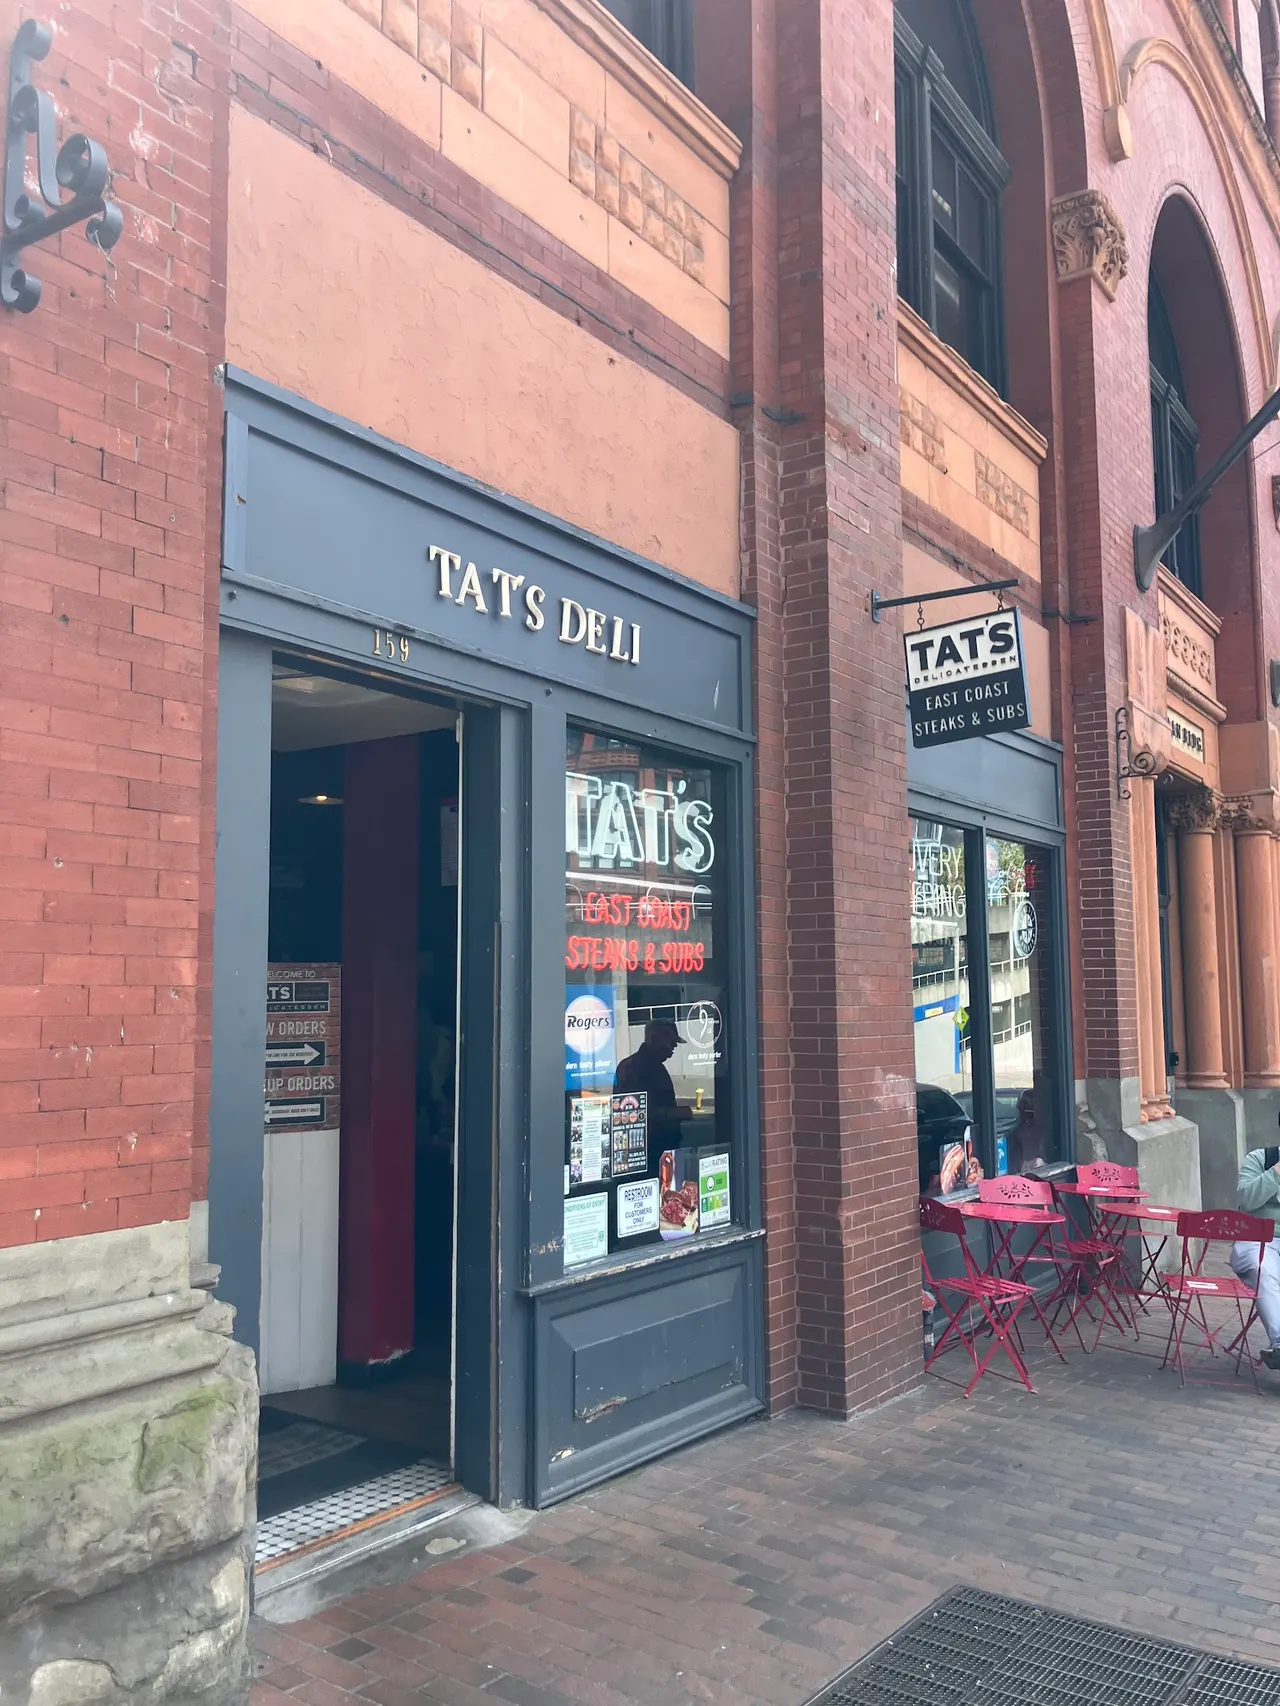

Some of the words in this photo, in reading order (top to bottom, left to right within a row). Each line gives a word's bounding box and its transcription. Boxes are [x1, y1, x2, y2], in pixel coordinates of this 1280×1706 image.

[428, 545, 546, 632] TAT'S
[558, 597, 642, 666] DELI
[372, 628, 410, 663] 159
[910, 619, 1014, 672] TAT'S
[914, 655, 1017, 684] DELICATESSEN
[925, 691, 959, 711] EAST
[965, 680, 1010, 702] COAST
[915, 714, 965, 737] STEAKS
[972, 711, 981, 726] &
[987, 702, 1025, 723] SUBS
[565, 771, 715, 873] TAT'S
[585, 891, 633, 927] EAST
[636, 896, 692, 931] COAST
[565, 935, 639, 971] STEAKS
[644, 942, 656, 973] &
[658, 942, 704, 973] SUBS
[278, 1020, 326, 1036] ORDERS
[567, 1015, 610, 1031] Rogers
[287, 1075, 335, 1092] ORDERS
[712, 1157, 728, 1167] RATING
[624, 1185, 653, 1202] RESTROOM
[633, 1201, 643, 1209] FOR
[625, 1207, 653, 1219] CUSTOMERS
